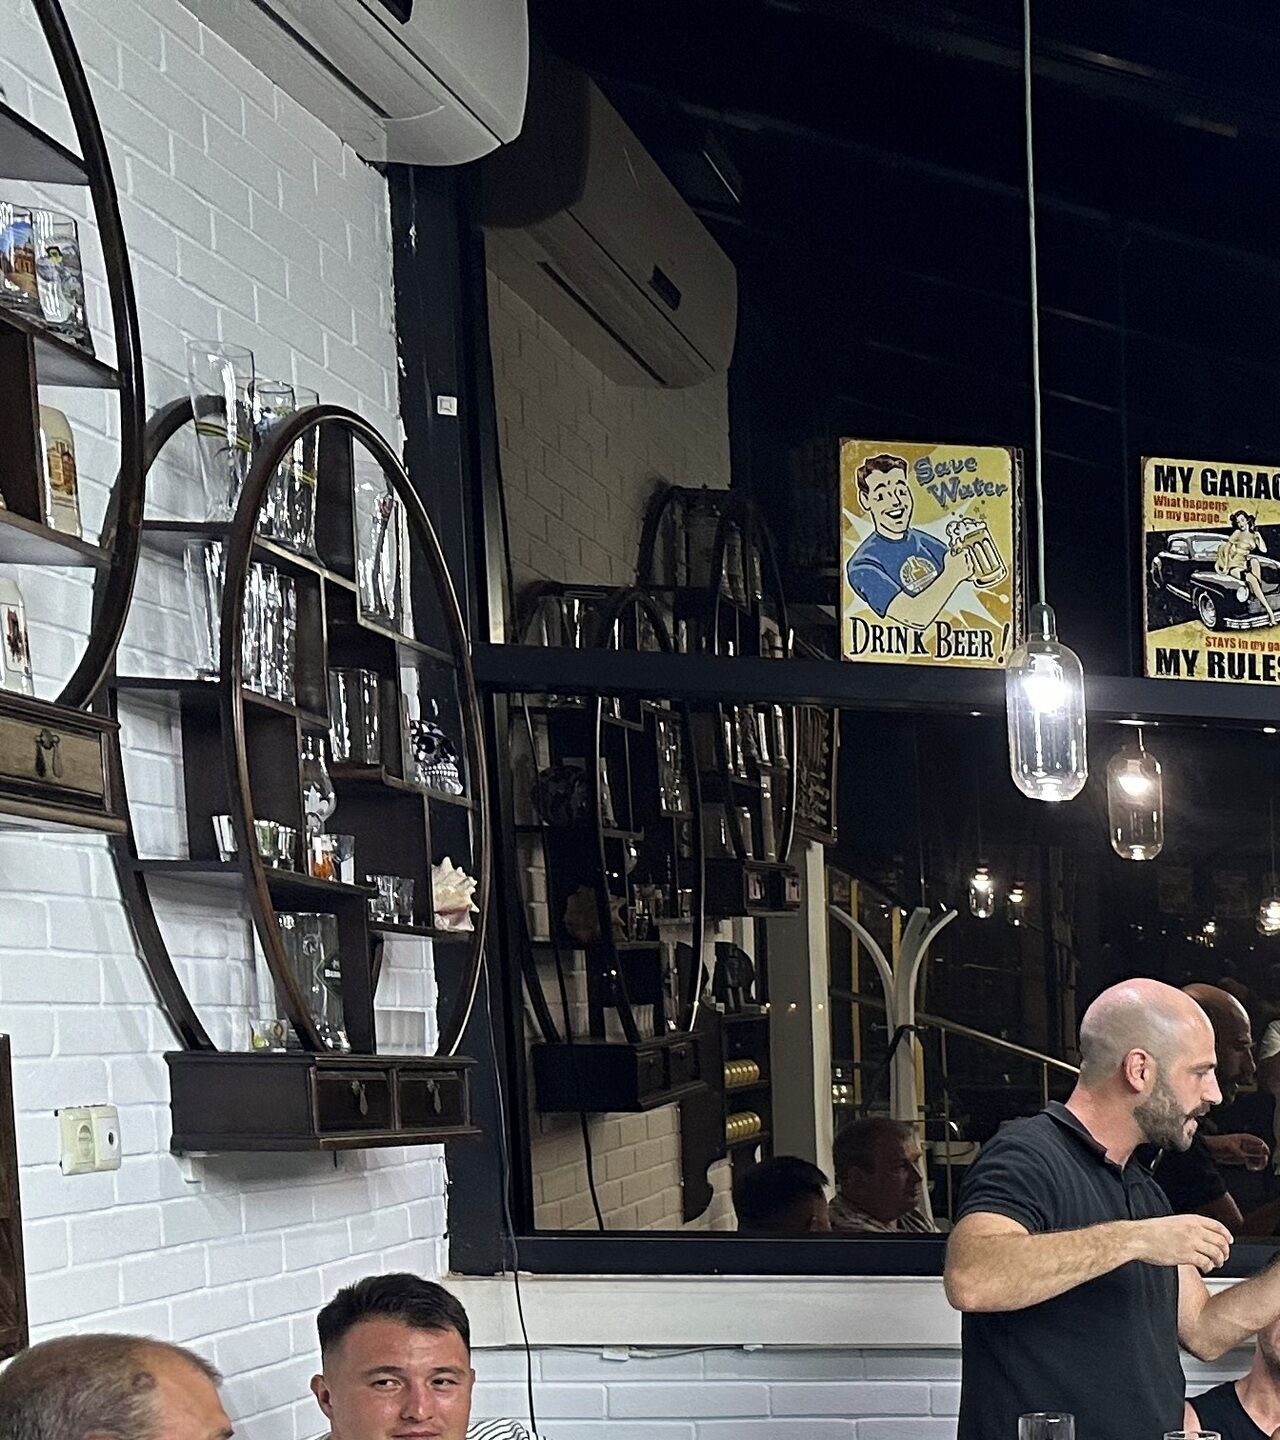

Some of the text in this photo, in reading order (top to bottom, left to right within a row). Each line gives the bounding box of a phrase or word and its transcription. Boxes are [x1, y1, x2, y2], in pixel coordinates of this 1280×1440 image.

[914, 456, 977, 486] Save
[1153, 464, 1194, 494] MY
[926, 476, 1009, 507] Water
[1153, 494, 1228, 511] What happens
[1153, 508, 1165, 519] in
[1166, 511, 1181, 522] my
[849, 617, 930, 655] DRINK
[1205, 636, 1237, 649] STAYS
[1238, 637, 1249, 649] in
[1250, 640, 1266, 653] my
[1155, 648, 1200, 677] MY
